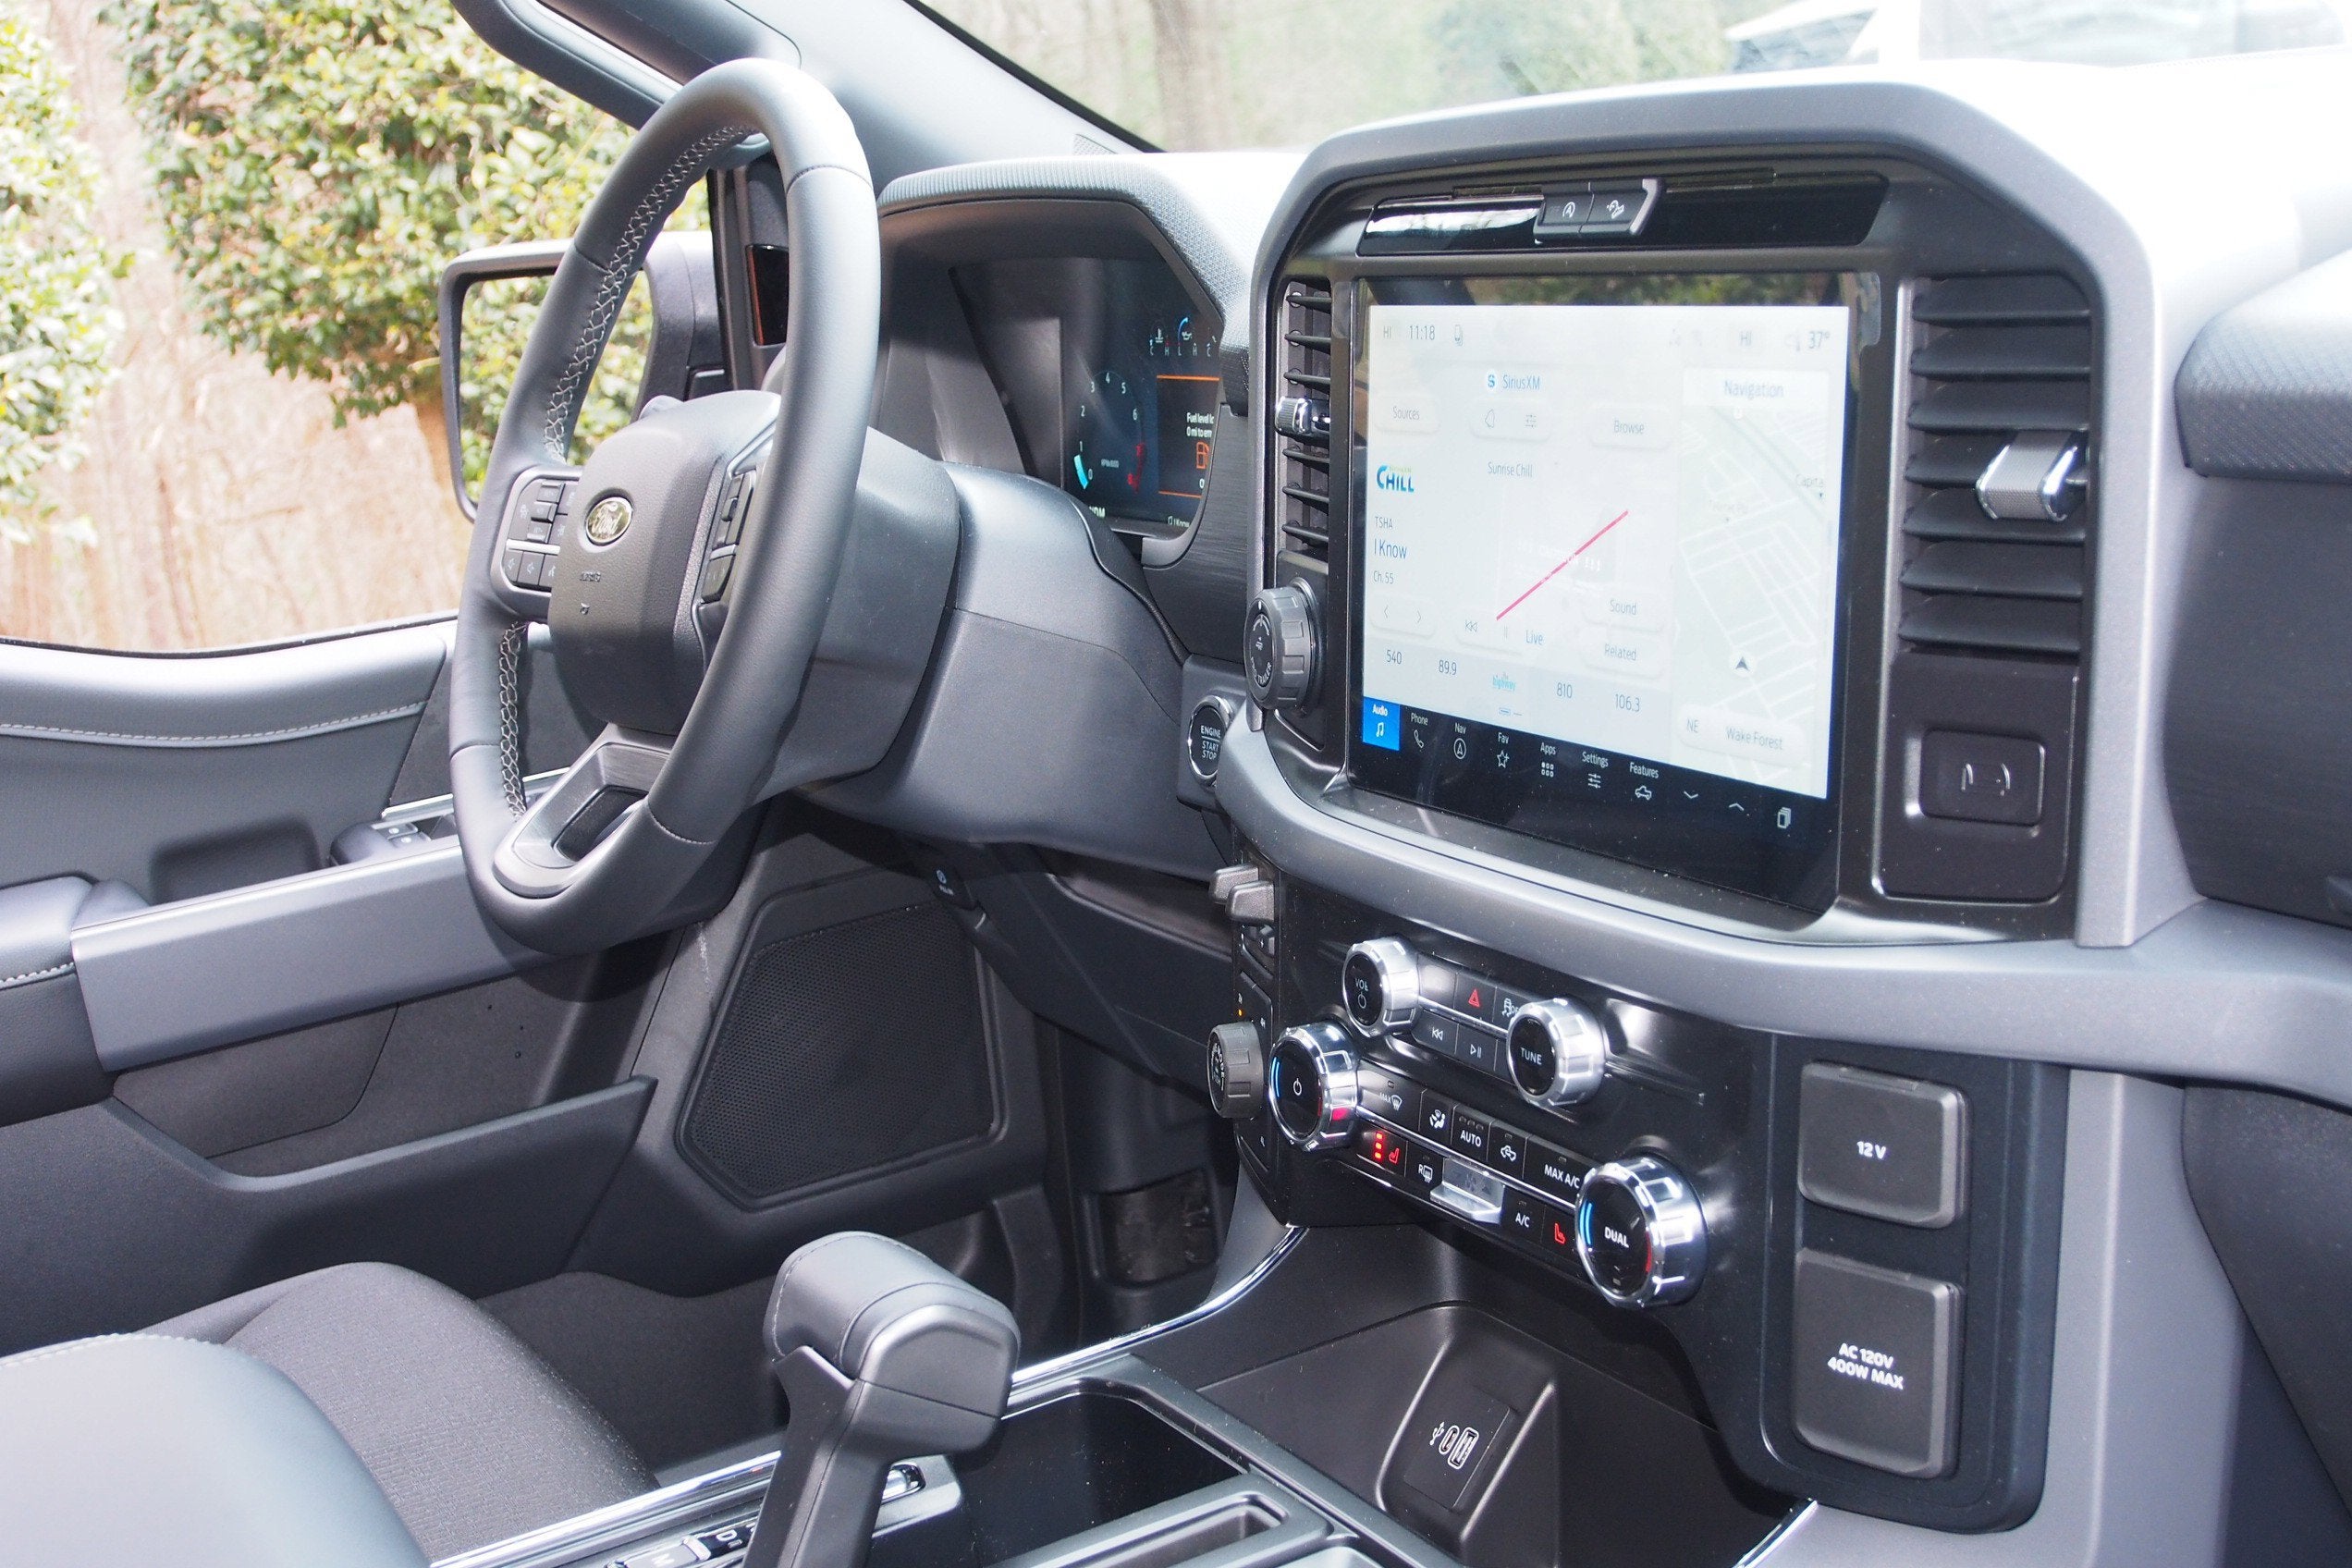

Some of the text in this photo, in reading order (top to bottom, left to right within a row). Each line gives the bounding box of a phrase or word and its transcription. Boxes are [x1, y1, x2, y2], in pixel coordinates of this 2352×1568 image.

[1409, 325, 1436, 341] 11:18
[1739, 331, 1752, 347] HI
[1106, 372, 1109, 383] 4
[1502, 374, 1540, 391] SiriusXM
[1091, 382, 1095, 393] 3
[1121, 383, 1126, 394] 5
[1724, 380, 1784, 400] Navigation
[1082, 405, 1085, 416] 2
[1133, 409, 1137, 420] 6
[1392, 406, 1420, 421] Sources
[1613, 417, 1645, 435] Browse
[1088, 469, 1093, 481] 0
[1488, 461, 1533, 478] Sunrise Chill
[1377, 465, 1415, 493] CHILL
[592, 503, 622, 534] Ford
[1375, 516, 1392, 529] TSHA
[1379, 539, 1408, 559] Know
[1373, 570, 1394, 584] Ch. 55
[1610, 598, 1637, 616] Sound
[1525, 630, 1544, 645] Live
[1387, 650, 1403, 665] 540
[1604, 643, 1637, 661] Related
[1257, 661, 1272, 686] TRAILER
[1439, 659, 1457, 676] 89.9
[1557, 682, 1573, 699] 810
[1372, 704, 1389, 717] Audio
[1615, 693, 1640, 713] 106.3
[1410, 712, 1428, 727] Phone
[1686, 717, 1699, 733] NE
[1200, 725, 1221, 739] ENGINE
[1454, 722, 1466, 735] Nav
[1202, 740, 1219, 752] START
[1498, 732, 1509, 745] Fav
[1725, 725, 1783, 751] Wake Forest
[1202, 749, 1217, 760] STOP
[1540, 741, 1556, 756] Apps
[1582, 751, 1609, 768] Settings
[1629, 762, 1660, 779] Features
[1520, 1047, 1542, 1066] TUNE
[1460, 1130, 1482, 1148] AUTO
[1544, 1163, 1581, 1190] MAX A/C
[1515, 1212, 1530, 1229] A/C
[1604, 1226, 1630, 1249] DUAL
[1838, 1342, 1893, 1370] AC 120V
[1827, 1356, 1905, 1390] 400W MAX
